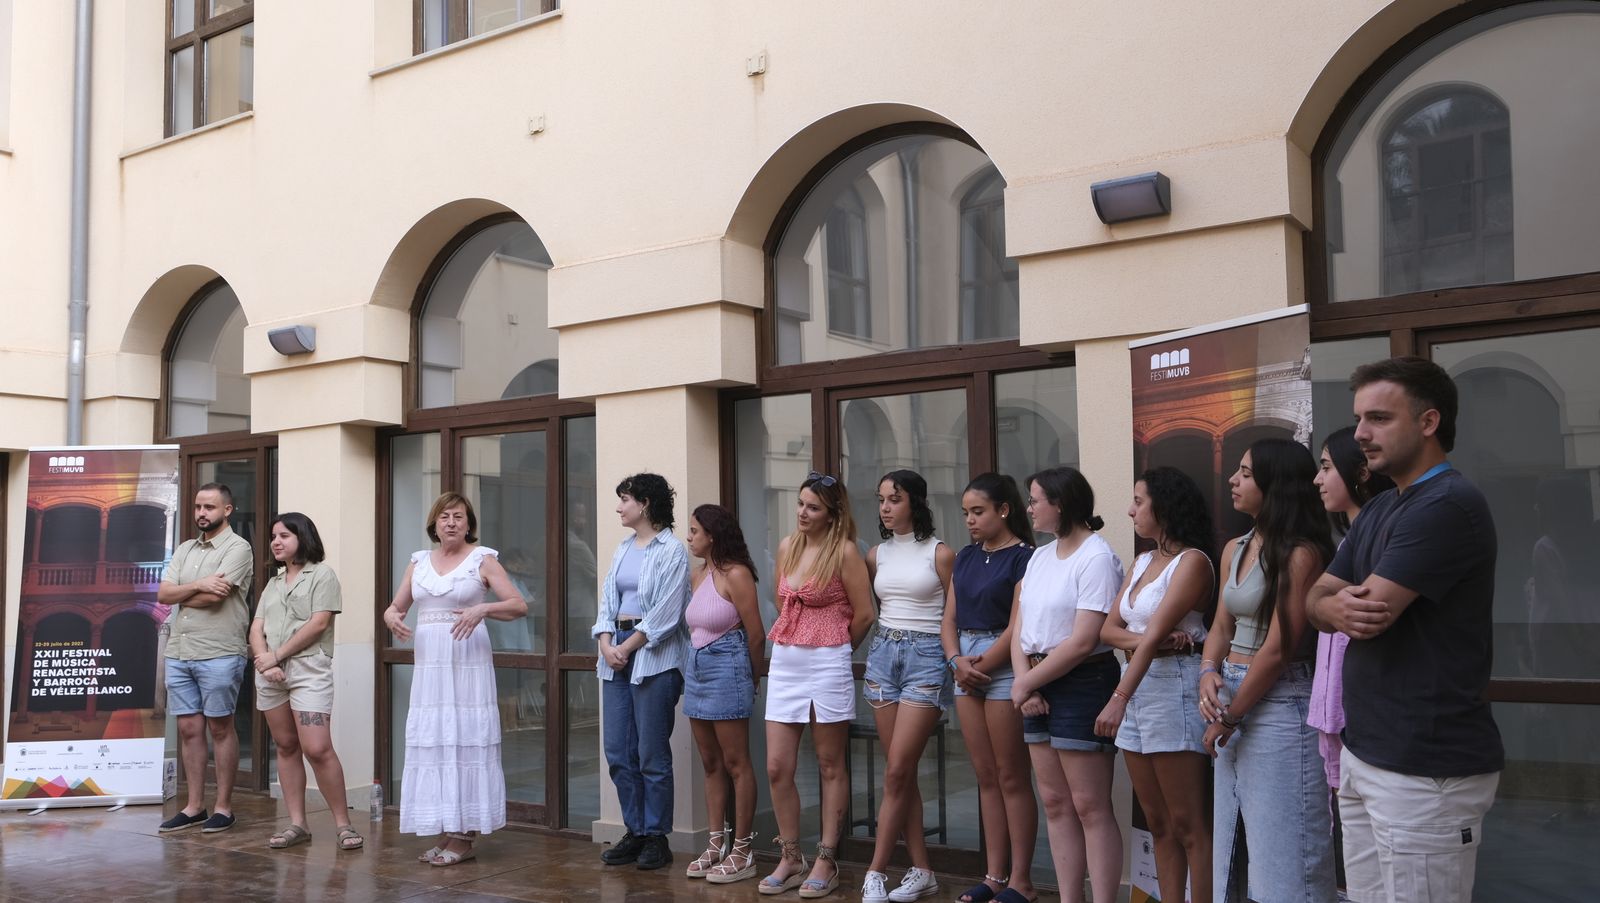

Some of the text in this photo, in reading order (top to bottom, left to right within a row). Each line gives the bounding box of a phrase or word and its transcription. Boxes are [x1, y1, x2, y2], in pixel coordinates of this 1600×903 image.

[1150, 366, 1190, 381] FESTIMUVB
[34, 649, 112, 658] XXII FESTIVAL
[33, 658, 96, 667] DE MÚSICA
[33, 667, 116, 677] RENACENTISTA
[43, 677, 98, 686] BARROCA
[31, 685, 132, 696] DE VÉLEZ BLANCO
